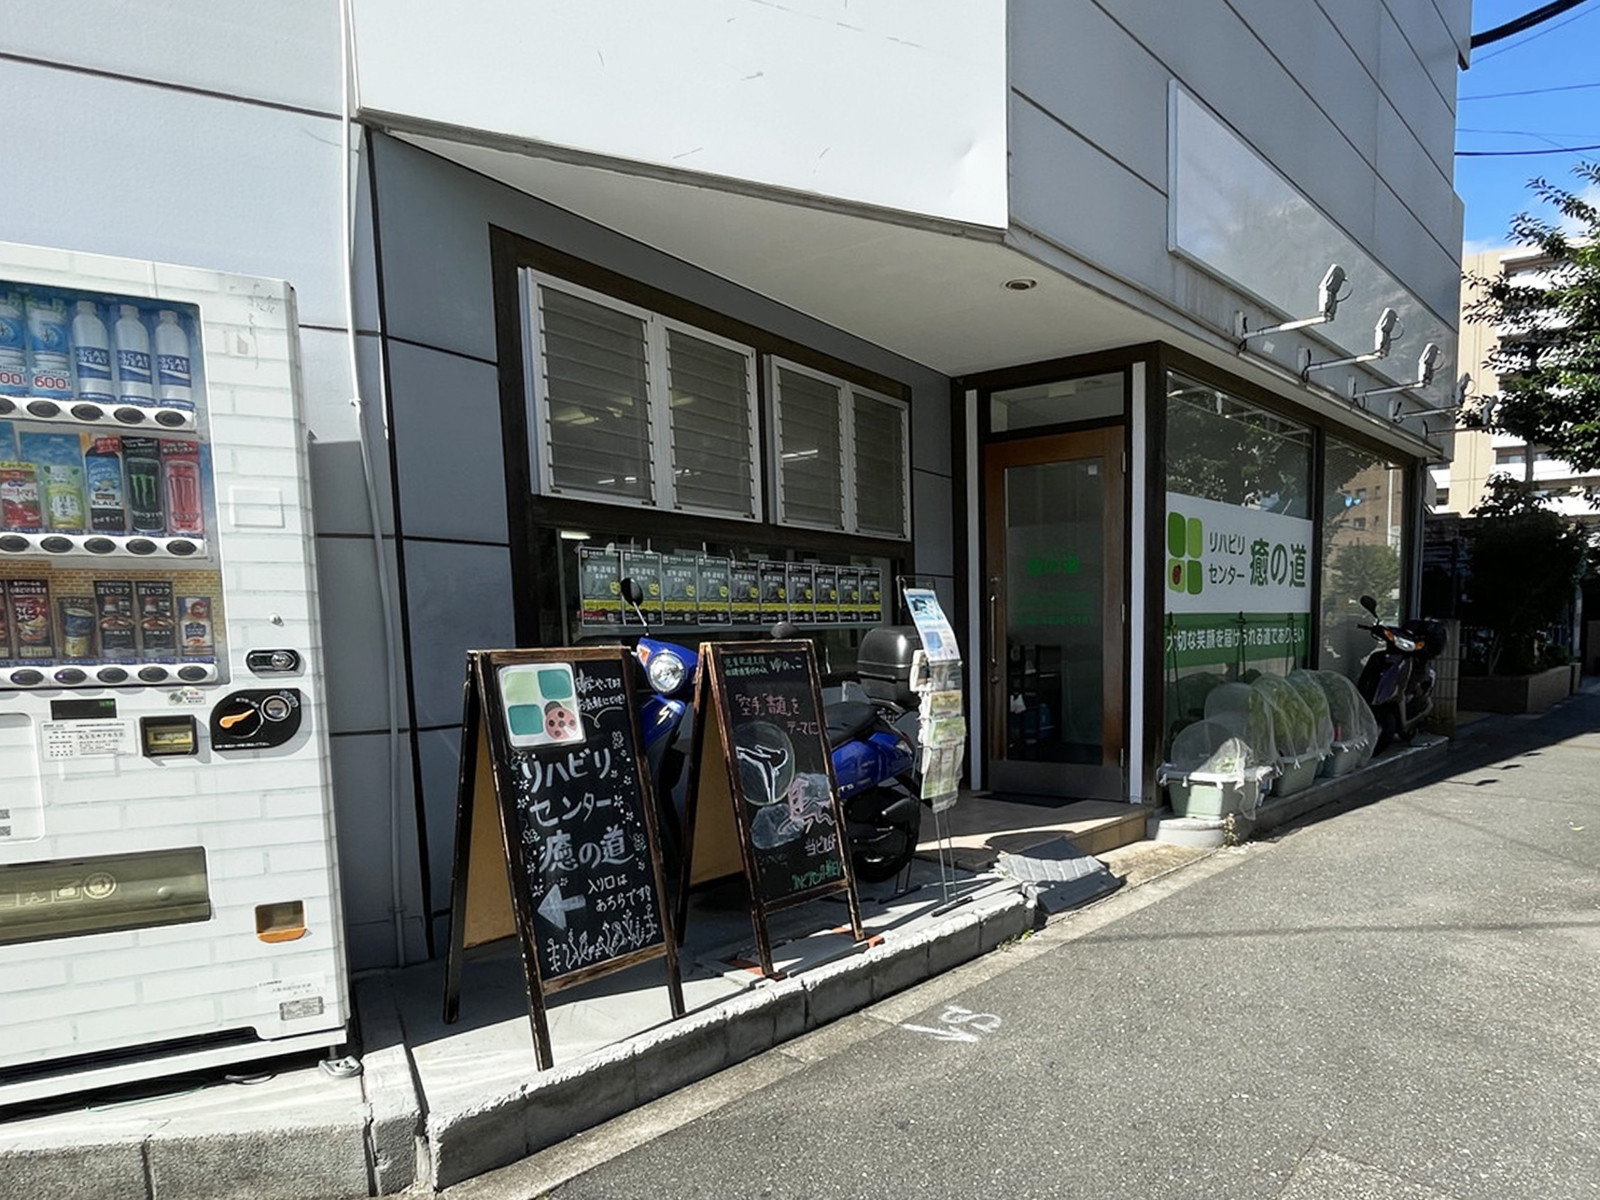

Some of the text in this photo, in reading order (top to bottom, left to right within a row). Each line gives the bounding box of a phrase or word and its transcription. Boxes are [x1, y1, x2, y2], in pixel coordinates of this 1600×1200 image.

[0, 372, 22, 385] 00
[34, 376, 67, 389] 600
[1209, 532, 1245, 556] リハビリ
[1209, 563, 1245, 585] センター
[1250, 538, 1306, 587] 癒の道
[521, 746, 611, 793] リハビリ
[530, 794, 612, 828] センター
[538, 825, 636, 873] 癒の道
[587, 874, 628, 895] 入り口は
